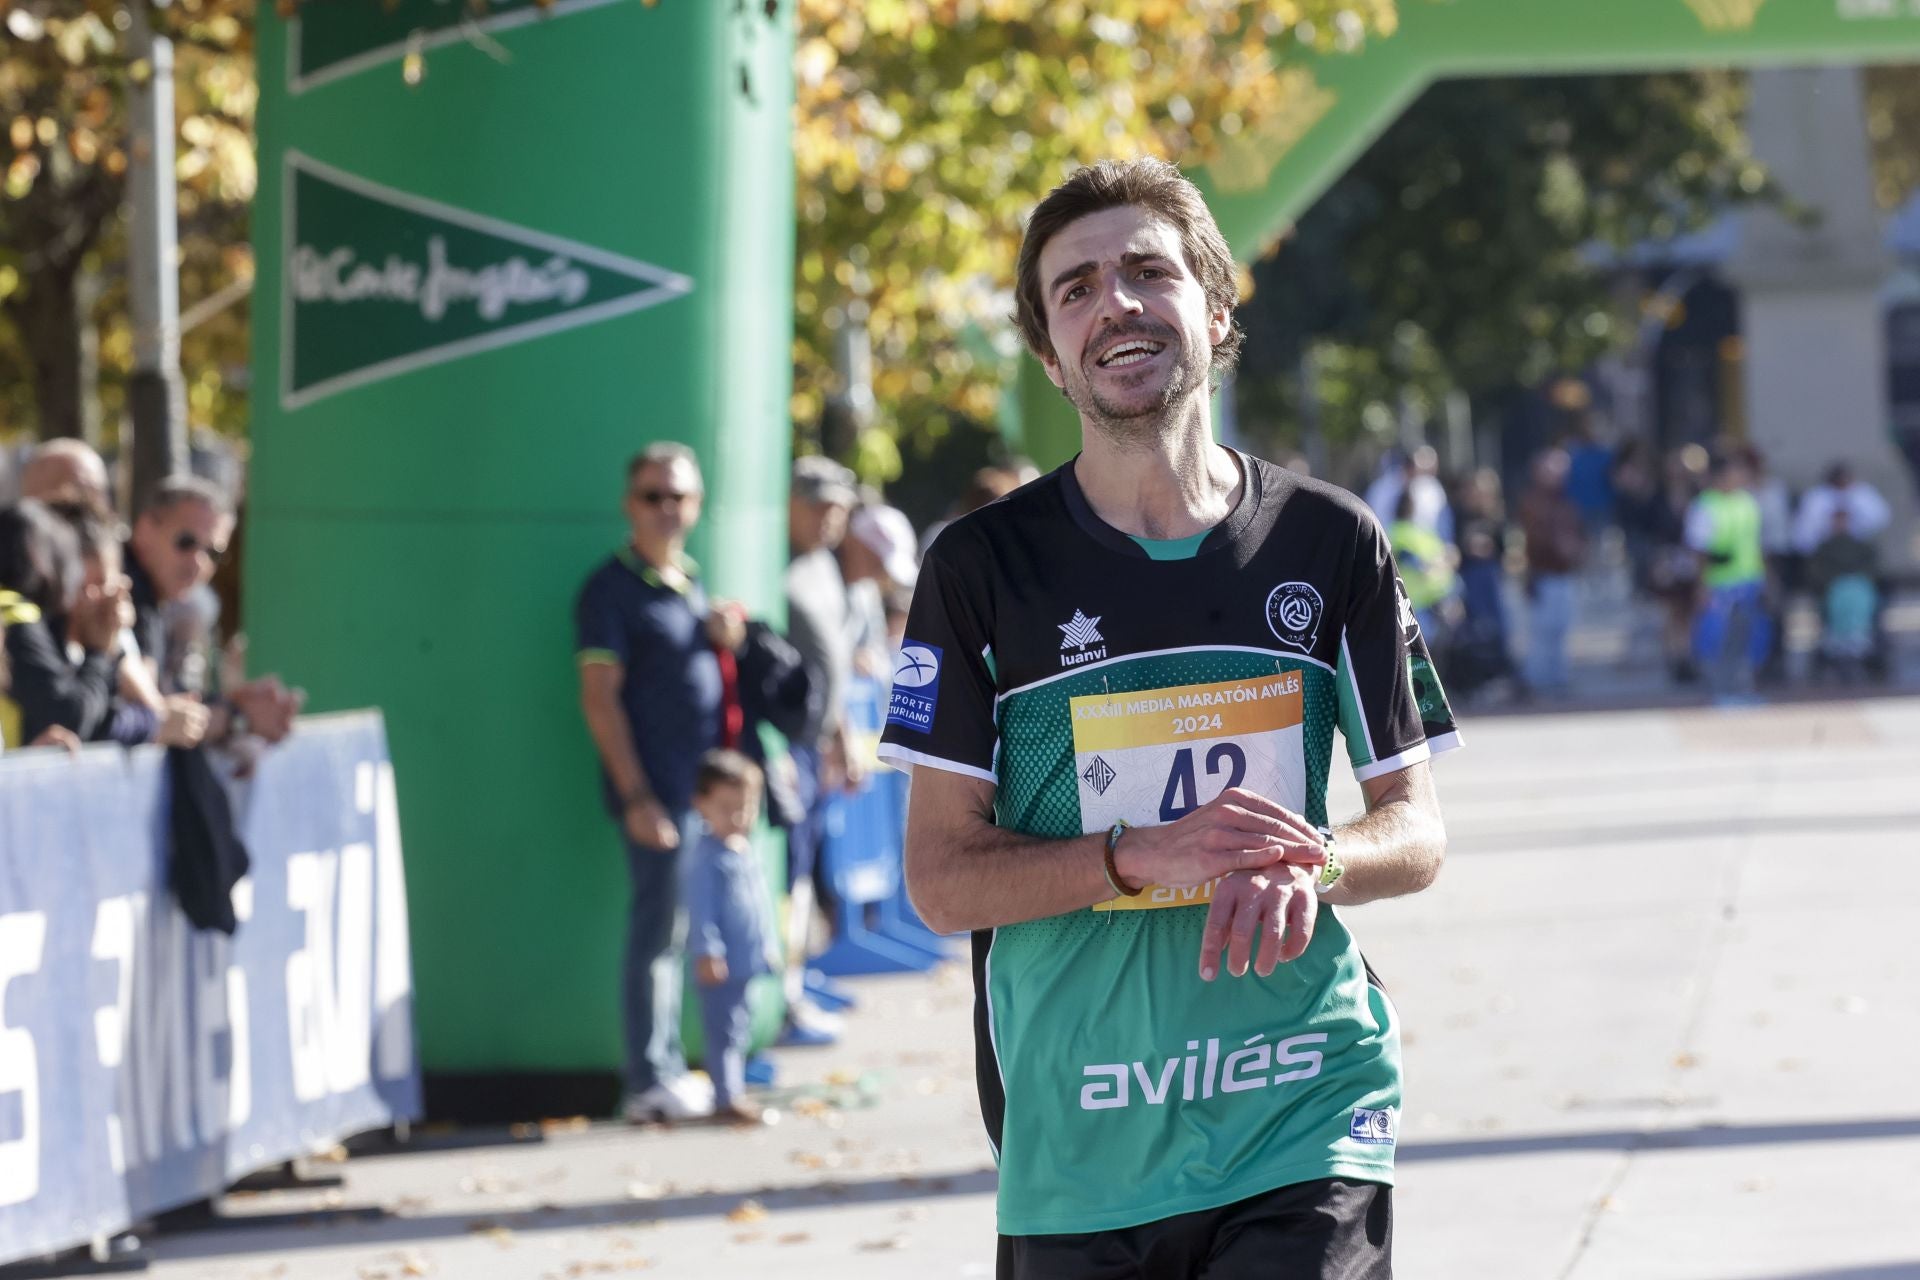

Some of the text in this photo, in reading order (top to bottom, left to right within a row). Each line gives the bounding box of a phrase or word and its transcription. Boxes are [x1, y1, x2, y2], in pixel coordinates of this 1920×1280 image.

[1060, 645, 1107, 666] luanvi
[890, 694, 932, 712] EPORTE
[1075, 677, 1299, 720] XXXIII MEDIA MARATÓN AVILÉS
[888, 705, 930, 723] TURIANO
[1172, 713, 1223, 735] 2024
[1159, 742, 1247, 822] 42
[1080, 1033, 1329, 1111] avilés
